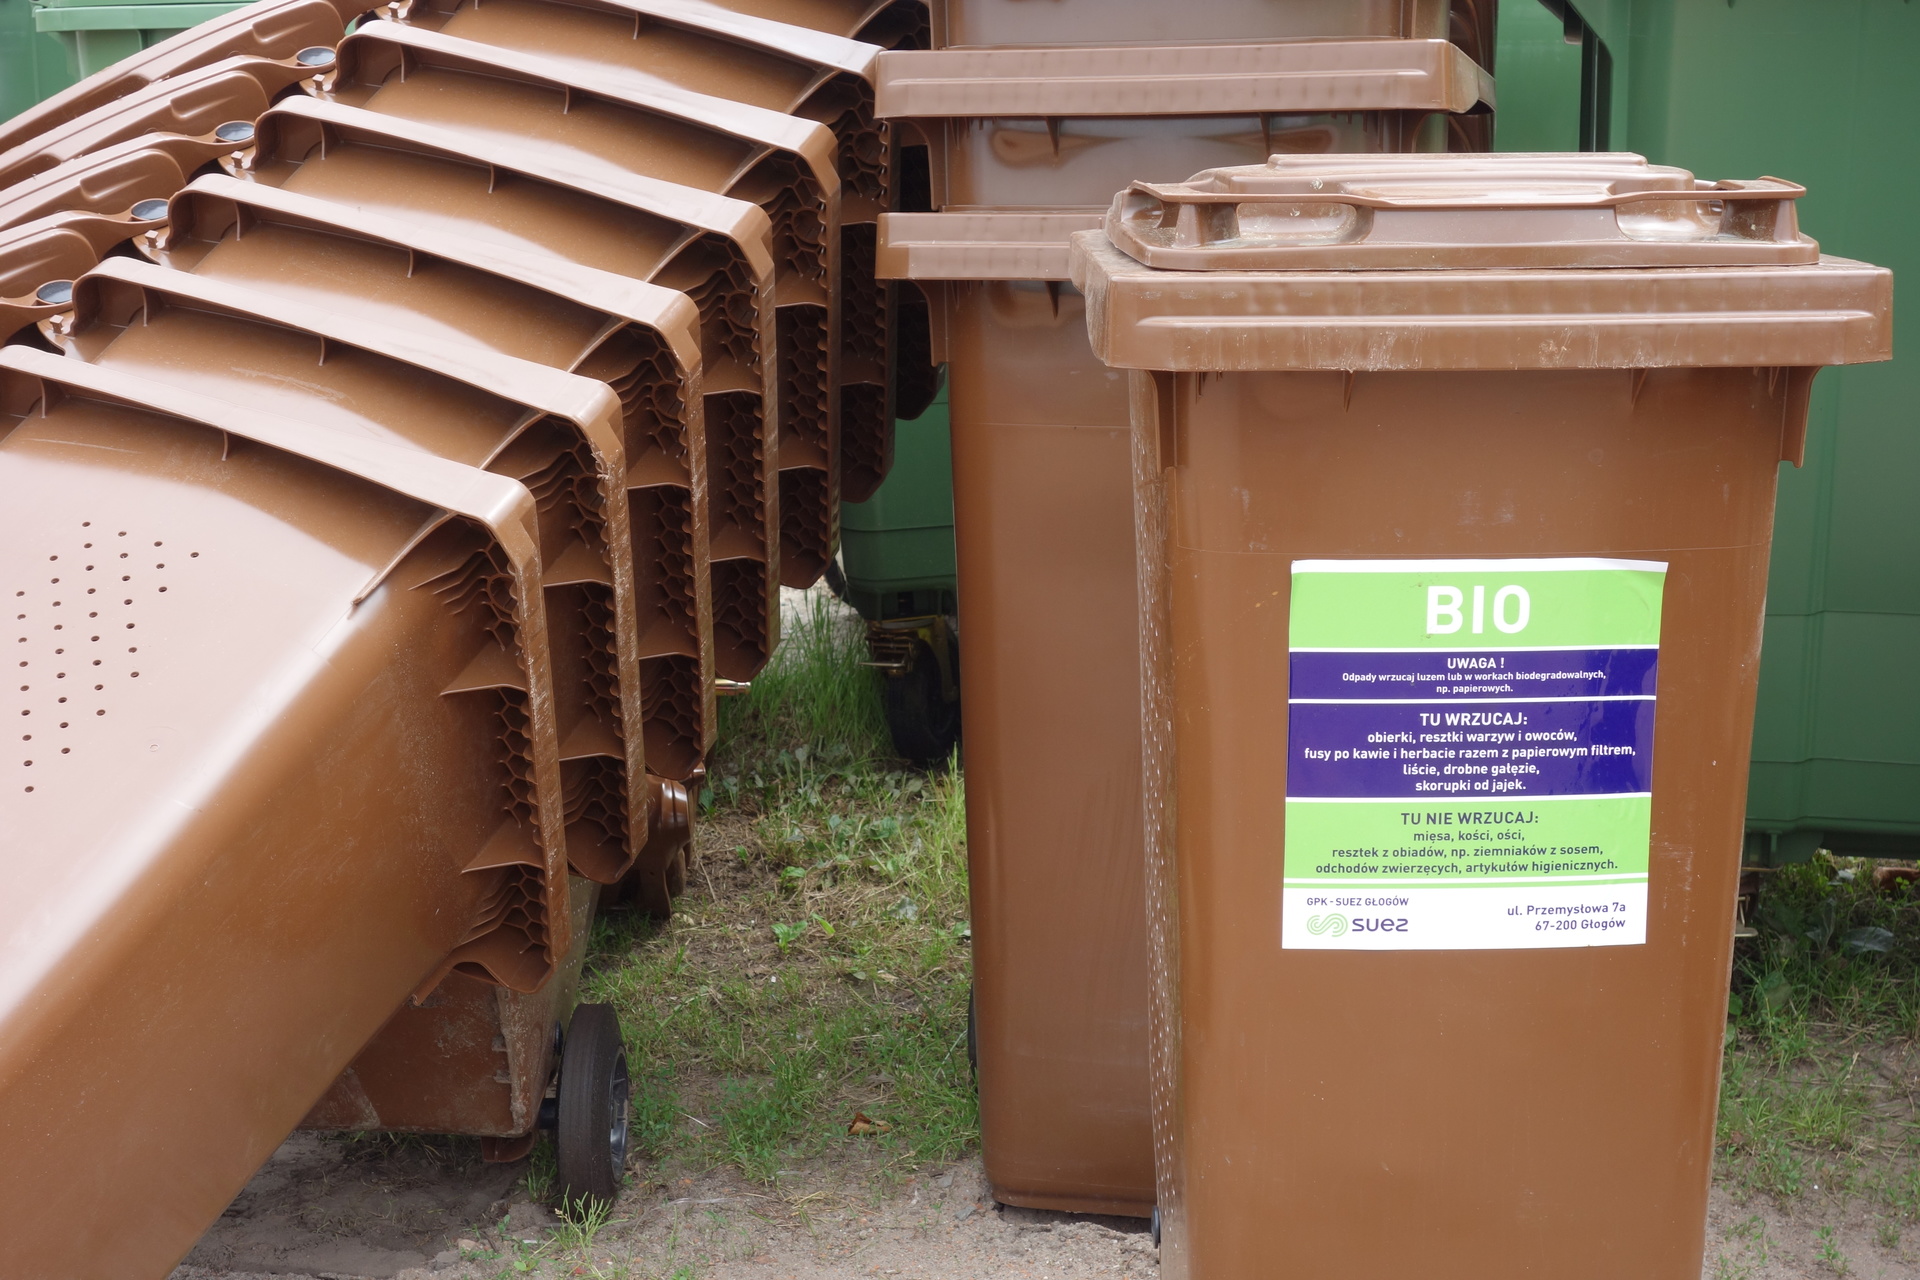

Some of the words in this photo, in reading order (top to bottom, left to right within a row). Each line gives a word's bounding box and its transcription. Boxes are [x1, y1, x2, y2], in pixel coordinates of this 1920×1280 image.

[1426, 584, 1531, 635] BIO
[1447, 657, 1496, 669] UWAGA
[1342, 672, 1377, 683] Odpady
[1378, 673, 1415, 683] wrzucaj
[1417, 673, 1445, 681] luzem
[1447, 673, 1462, 681] lub
[1464, 673, 1473, 681] w
[1474, 672, 1514, 680] workach
[1515, 670, 1606, 682] biodegradowalnych,
[1436, 685, 1451, 694] np.
[1452, 684, 1514, 694] papierowych.
[1420, 713, 1441, 726] TU
[1445, 712, 1528, 726] WRZUCAJ:
[1367, 731, 1416, 744] obierki,
[1420, 731, 1463, 743] resztki
[1466, 732, 1515, 744] warzyw
[1518, 730, 1521, 741] i
[1524, 729, 1578, 742] owoców,
[1304, 747, 1331, 761] fusy
[1334, 750, 1350, 761] po
[1353, 747, 1390, 759] kawie
[1393, 748, 1397, 759] i
[1400, 747, 1455, 759] herbacie
[1459, 749, 1499, 759] razem
[1501, 749, 1509, 758] z
[1511, 746, 1588, 760] papierowym
[1590, 745, 1636, 757] filtrem,
[1403, 763, 1440, 776] liście,
[1443, 763, 1488, 775] drobne
[1491, 762, 1540, 776] gałęzie,
[1415, 779, 1471, 793] skorupki
[1474, 779, 1489, 790] od
[1491, 778, 1527, 793] jajek.
[1401, 812, 1421, 825] TU
[1426, 812, 1453, 825] NIE
[1458, 811, 1539, 825] WRZUCAJ:
[1413, 830, 1455, 844] mięsa,
[1458, 829, 1493, 842] kości,
[1497, 829, 1525, 841] ości,
[1332, 847, 1379, 858] resztek
[1382, 849, 1389, 857] z
[1392, 846, 1447, 859] obiadów,
[1451, 848, 1470, 859] np.
[1473, 844, 1547, 857] ziemniaków
[1550, 846, 1557, 855] z
[1560, 845, 1604, 855] sosem,
[1315, 862, 1379, 874] odchodów
[1382, 862, 1462, 875] zwierzęcych,
[1465, 860, 1529, 875] artykułów
[1531, 859, 1618, 874] higienicznych.
[1365, 895, 1409, 906] GŁOGÓW
[1507, 905, 1523, 916] ul.
[1526, 903, 1609, 917] Przemysłowa
[1612, 901, 1626, 912] 7a
[1535, 920, 1577, 931] 67-200
[1580, 917, 1626, 931] Głogów
